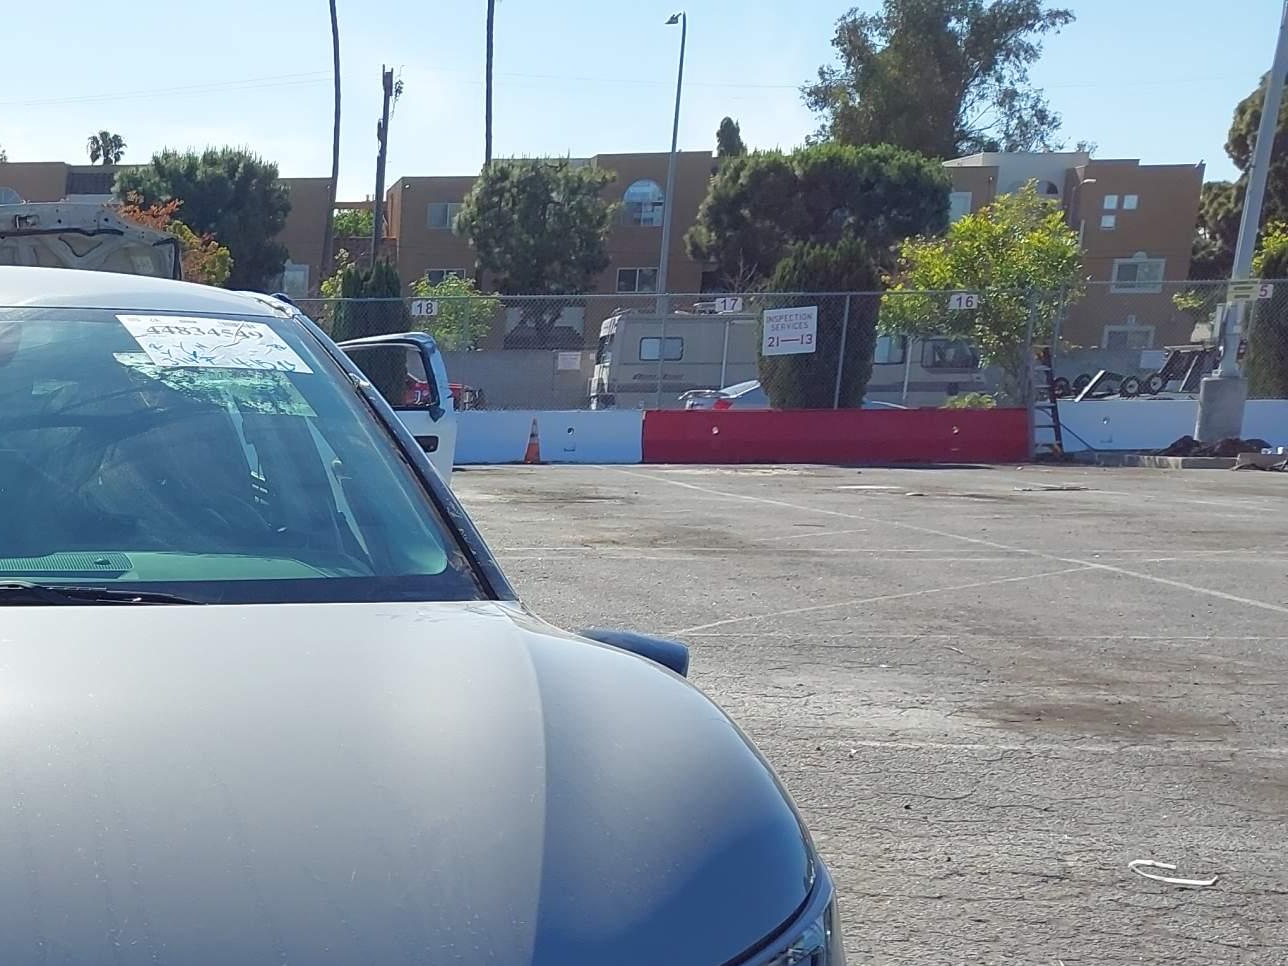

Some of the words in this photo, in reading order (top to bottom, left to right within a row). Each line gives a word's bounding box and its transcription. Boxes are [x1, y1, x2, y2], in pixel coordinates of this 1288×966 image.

[417, 302, 433, 314] 18
[721, 299, 738, 311] 17
[956, 296, 974, 308] 16
[767, 313, 812, 321] INSPECTION
[146, 325, 264, 339] 44834549
[772, 322, 809, 331] SERVICES
